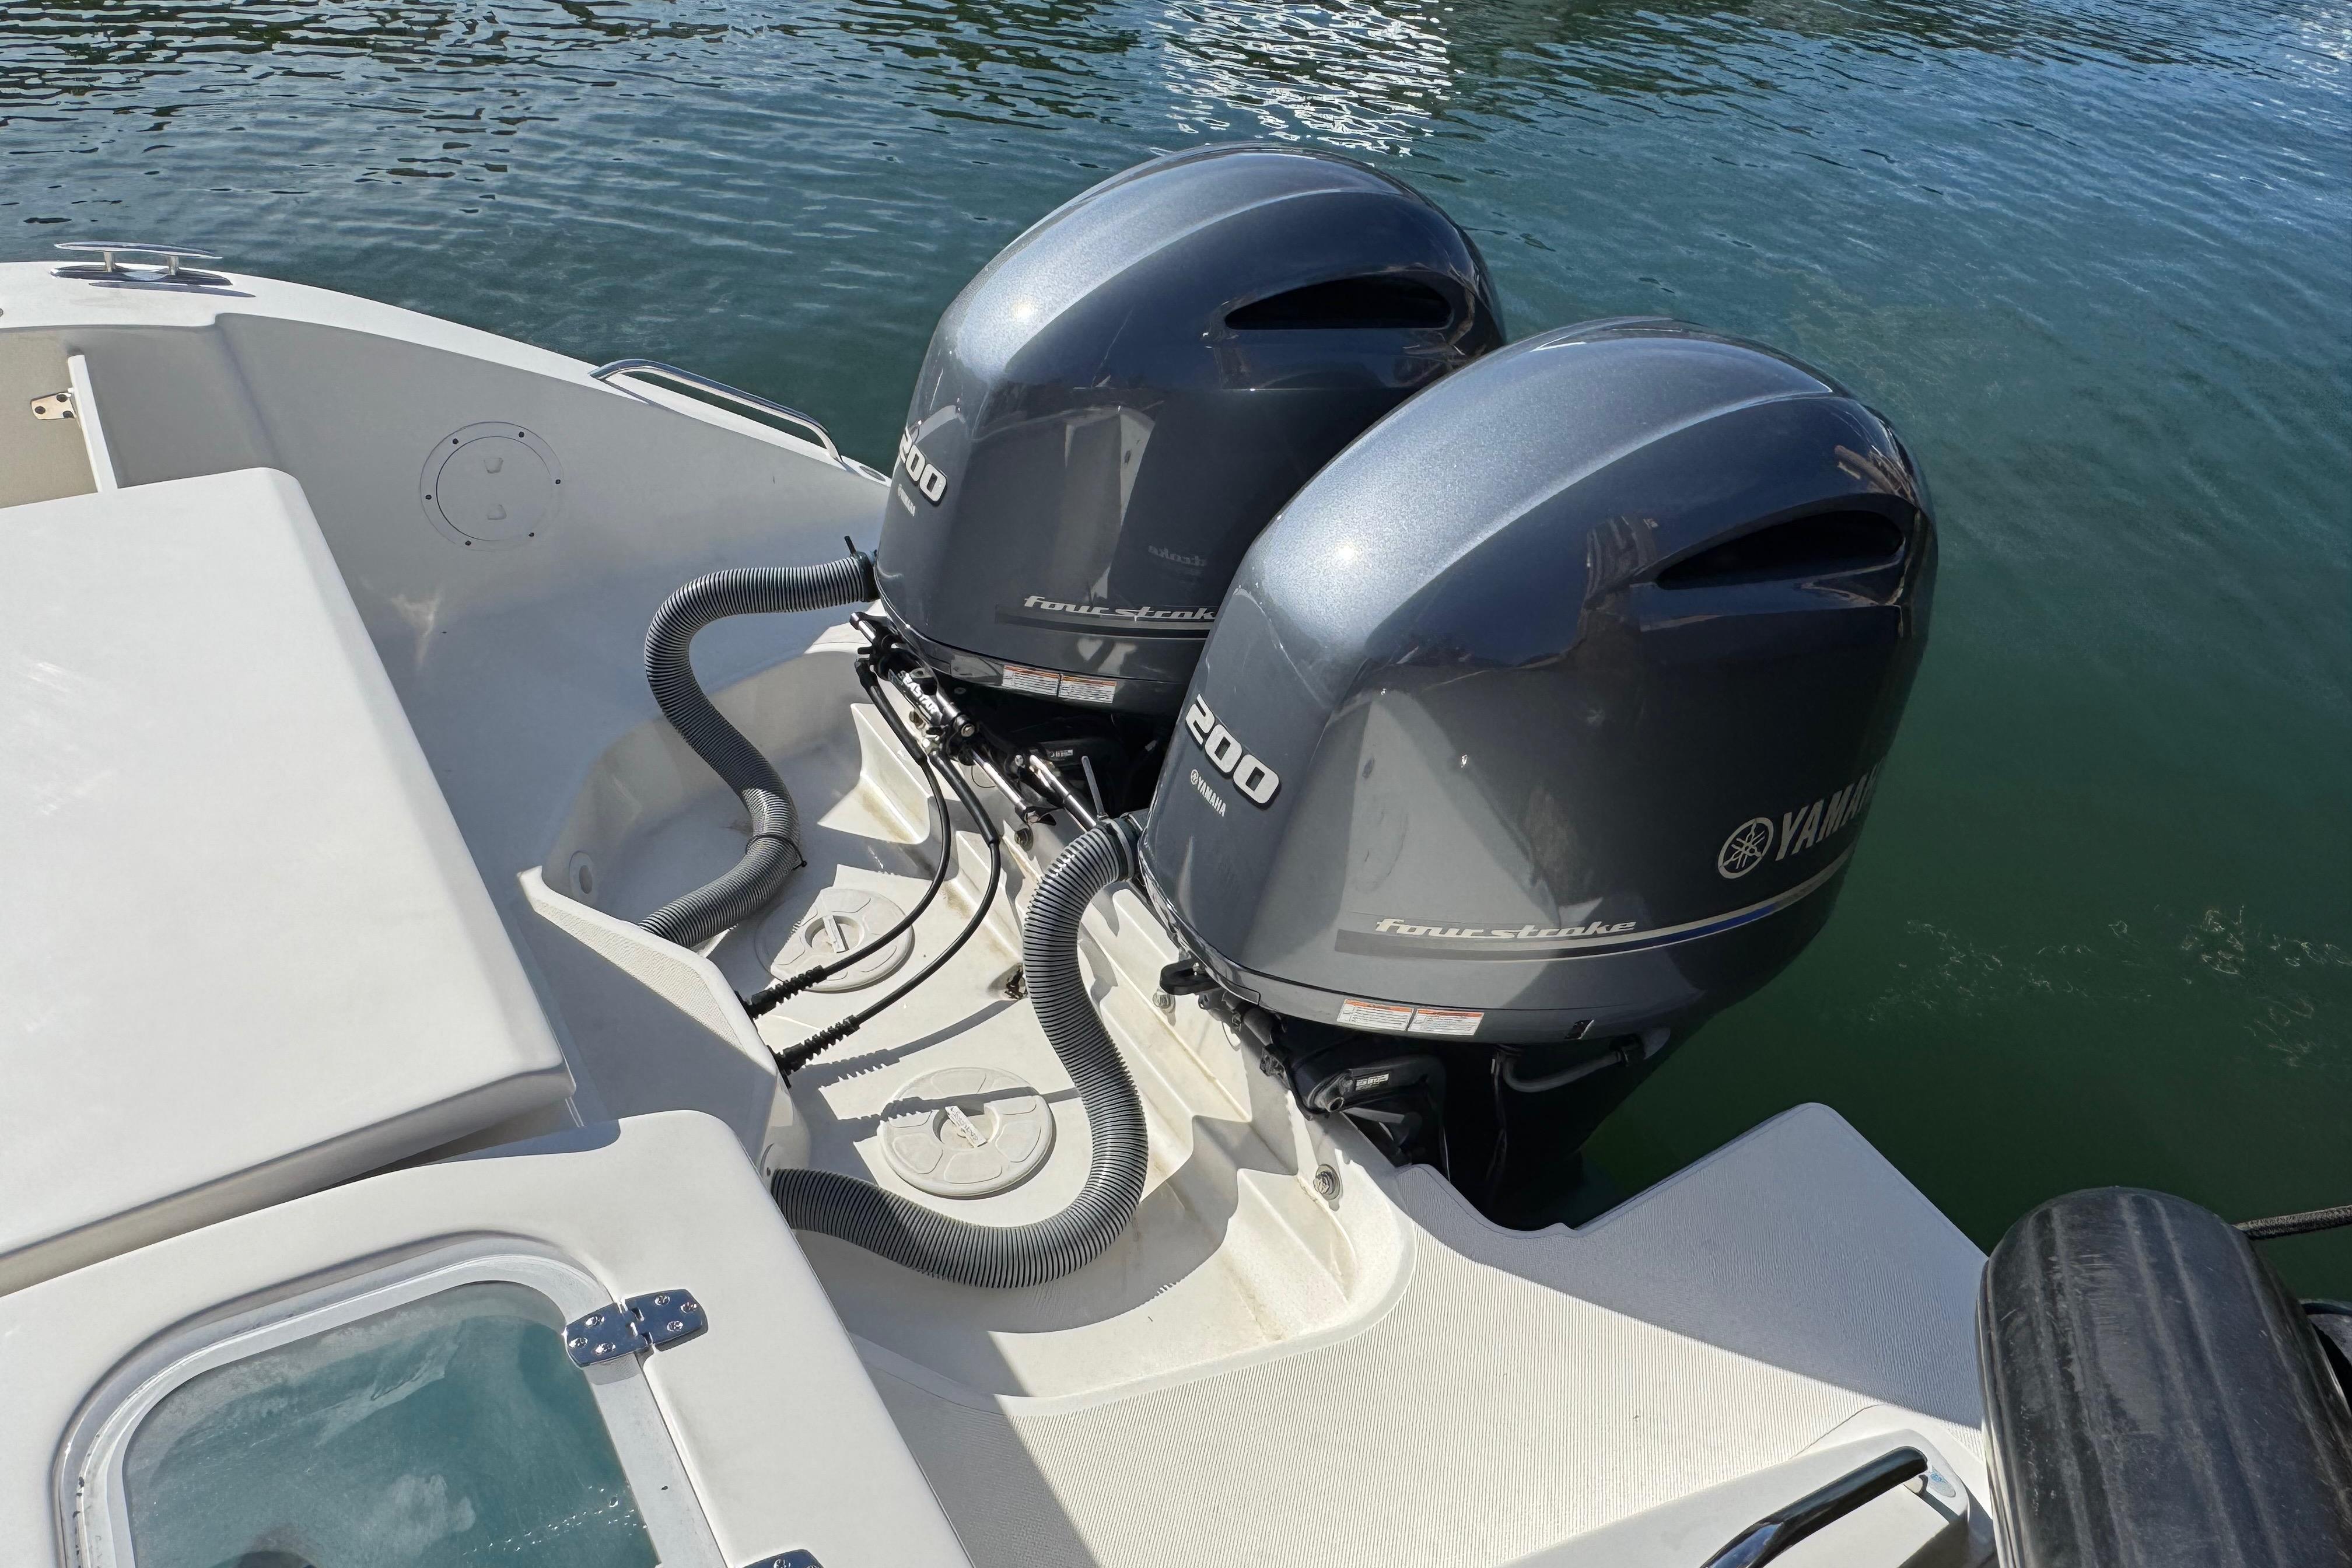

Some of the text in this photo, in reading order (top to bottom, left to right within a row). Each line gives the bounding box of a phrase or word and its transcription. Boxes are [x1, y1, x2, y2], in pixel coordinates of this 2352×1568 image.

[899, 426, 947, 502] 200
[1115, 607, 1216, 620] strok
[1185, 694, 1279, 804] 200
[1196, 776, 1227, 817] YAMAHA
